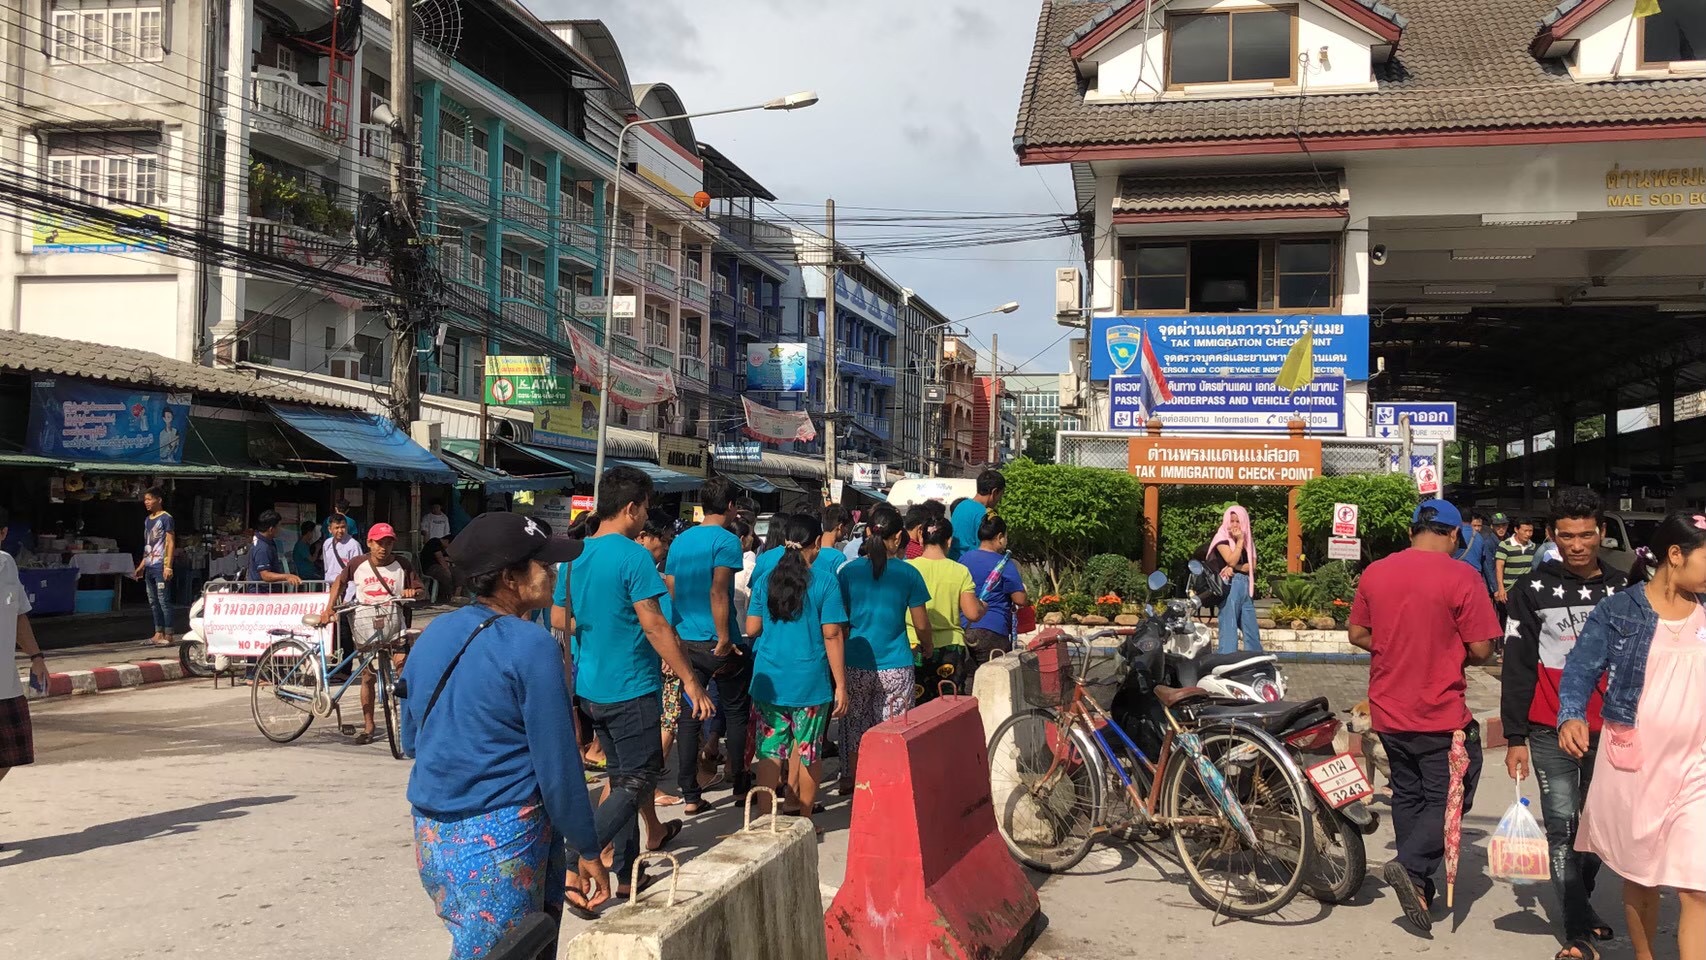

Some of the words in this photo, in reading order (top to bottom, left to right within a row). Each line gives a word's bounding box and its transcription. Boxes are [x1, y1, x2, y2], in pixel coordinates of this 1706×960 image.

[1608, 194, 1643, 207] MAE
[1649, 192, 1684, 206] SOD
[1170, 339, 1191, 347] TAK
[1194, 338, 1262, 347] IMMIGRATION
[531, 378, 558, 389] ATM
[1229, 396, 1248, 405] AND
[1252, 396, 1290, 405] VEHICLE
[1293, 396, 1337, 405] CONTROL
[1214, 415, 1259, 423] Information
[1148, 443, 1299, 463] ด่านพรมแดนแม่สอด
[1135, 465, 1156, 478] TAK
[1161, 465, 1234, 479] IMMIGRATION
[1238, 466, 1314, 480] CHECK-POINT
[238, 640, 251, 649] NO
[1332, 783, 1365, 802] 3243
